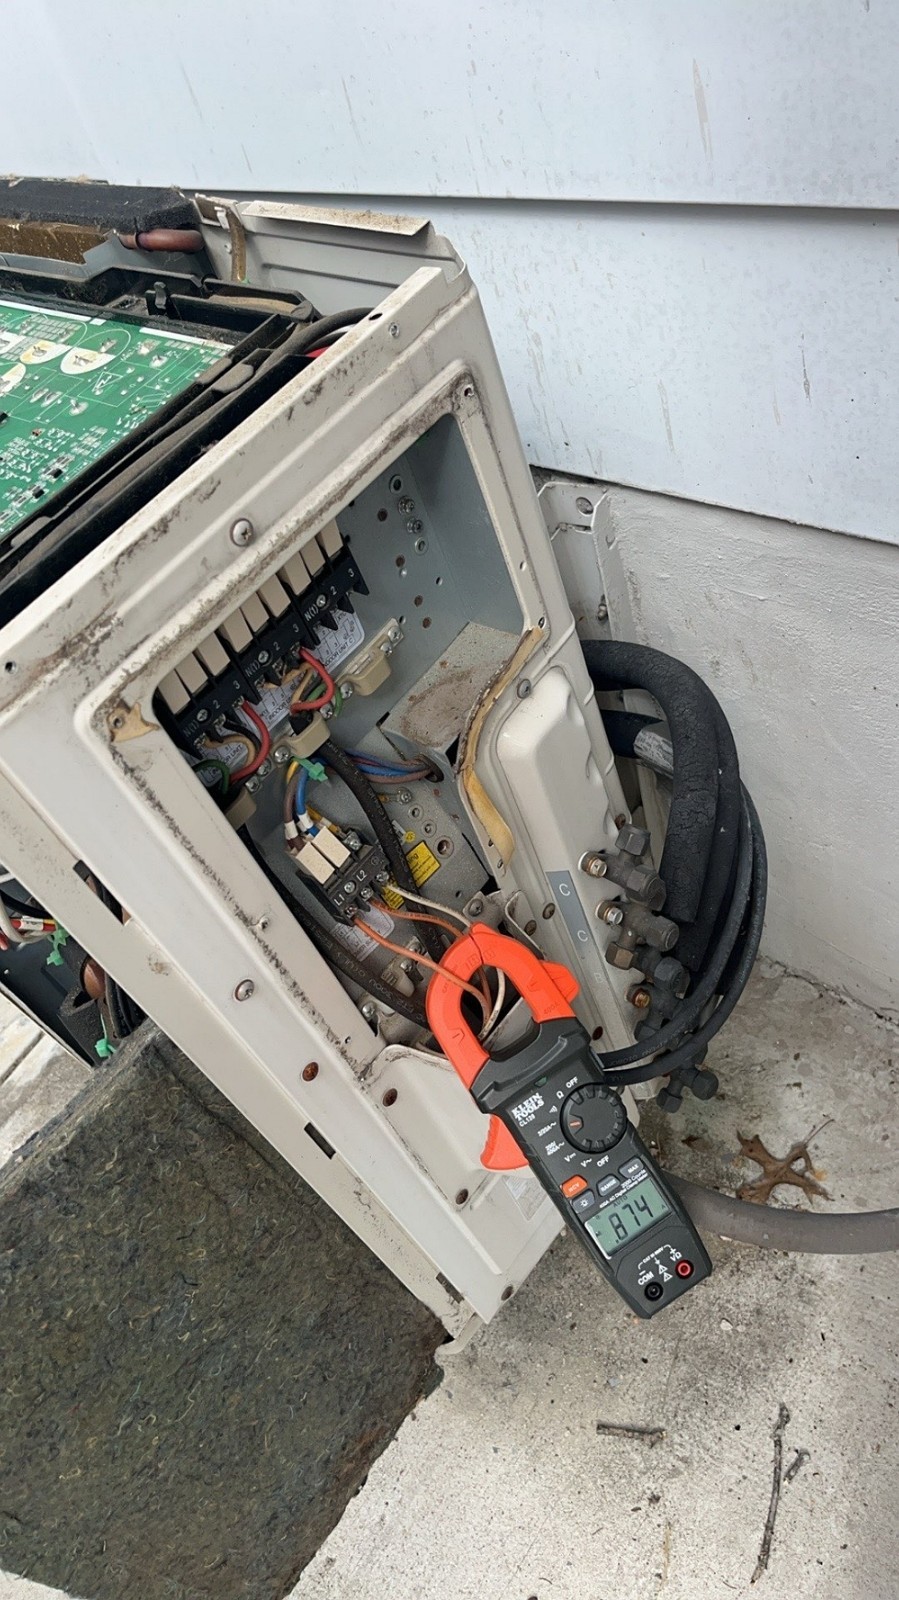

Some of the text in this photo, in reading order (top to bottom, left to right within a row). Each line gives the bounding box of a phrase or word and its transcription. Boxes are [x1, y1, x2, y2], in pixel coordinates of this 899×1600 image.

[304, 568, 355, 621] N(1) 2 3
[273, 641, 280, 651] 2
[292, 623, 299, 633] 3
[212, 699, 220, 709] 2
[233, 680, 240, 690] 3
[356, 870, 367, 881] L2
[559, 883, 571, 897] C
[334, 894, 345, 905] L1
[577, 930, 588, 942] C
[565, 1076, 578, 1088] OFF
[511, 1092, 542, 1117] KLEIN
[515, 1099, 544, 1121] TOOLS
[596, 1155, 609, 1167] OFF
[627, 1164, 640, 1174] MAX
[613, 1195, 628, 1208] AUTO
[638, 1271, 654, 1285] COM
